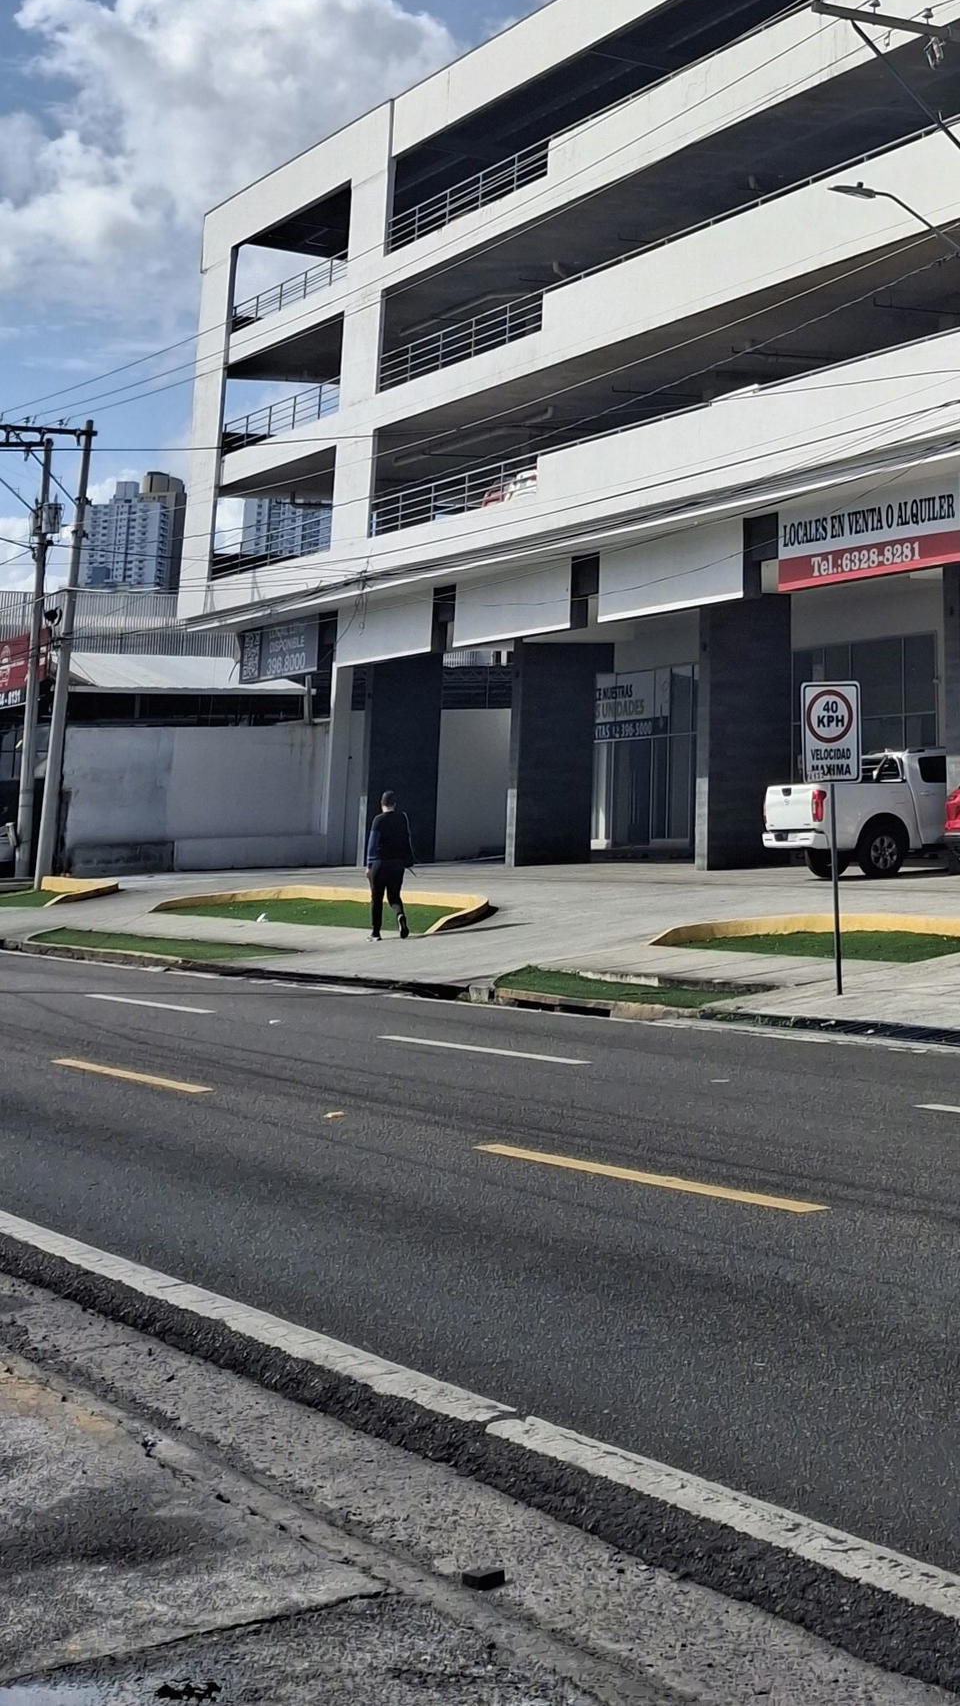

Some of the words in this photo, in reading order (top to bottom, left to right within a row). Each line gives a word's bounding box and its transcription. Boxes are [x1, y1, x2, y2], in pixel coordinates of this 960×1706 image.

[783, 517, 828, 548] LOCALES
[830, 511, 845, 539] EN
[847, 506, 883, 536] VENTA
[886, 504, 894, 529] O
[896, 493, 956, 527] ALQUILER
[602, 684, 633, 701] NUESTRAS
[602, 698, 645, 719] UNIDADES
[822, 700, 839, 714] 40
[816, 714, 845, 728] KPH
[811, 747, 852, 761] VELOCIDAD
[811, 763, 852, 776] MAXIMA
